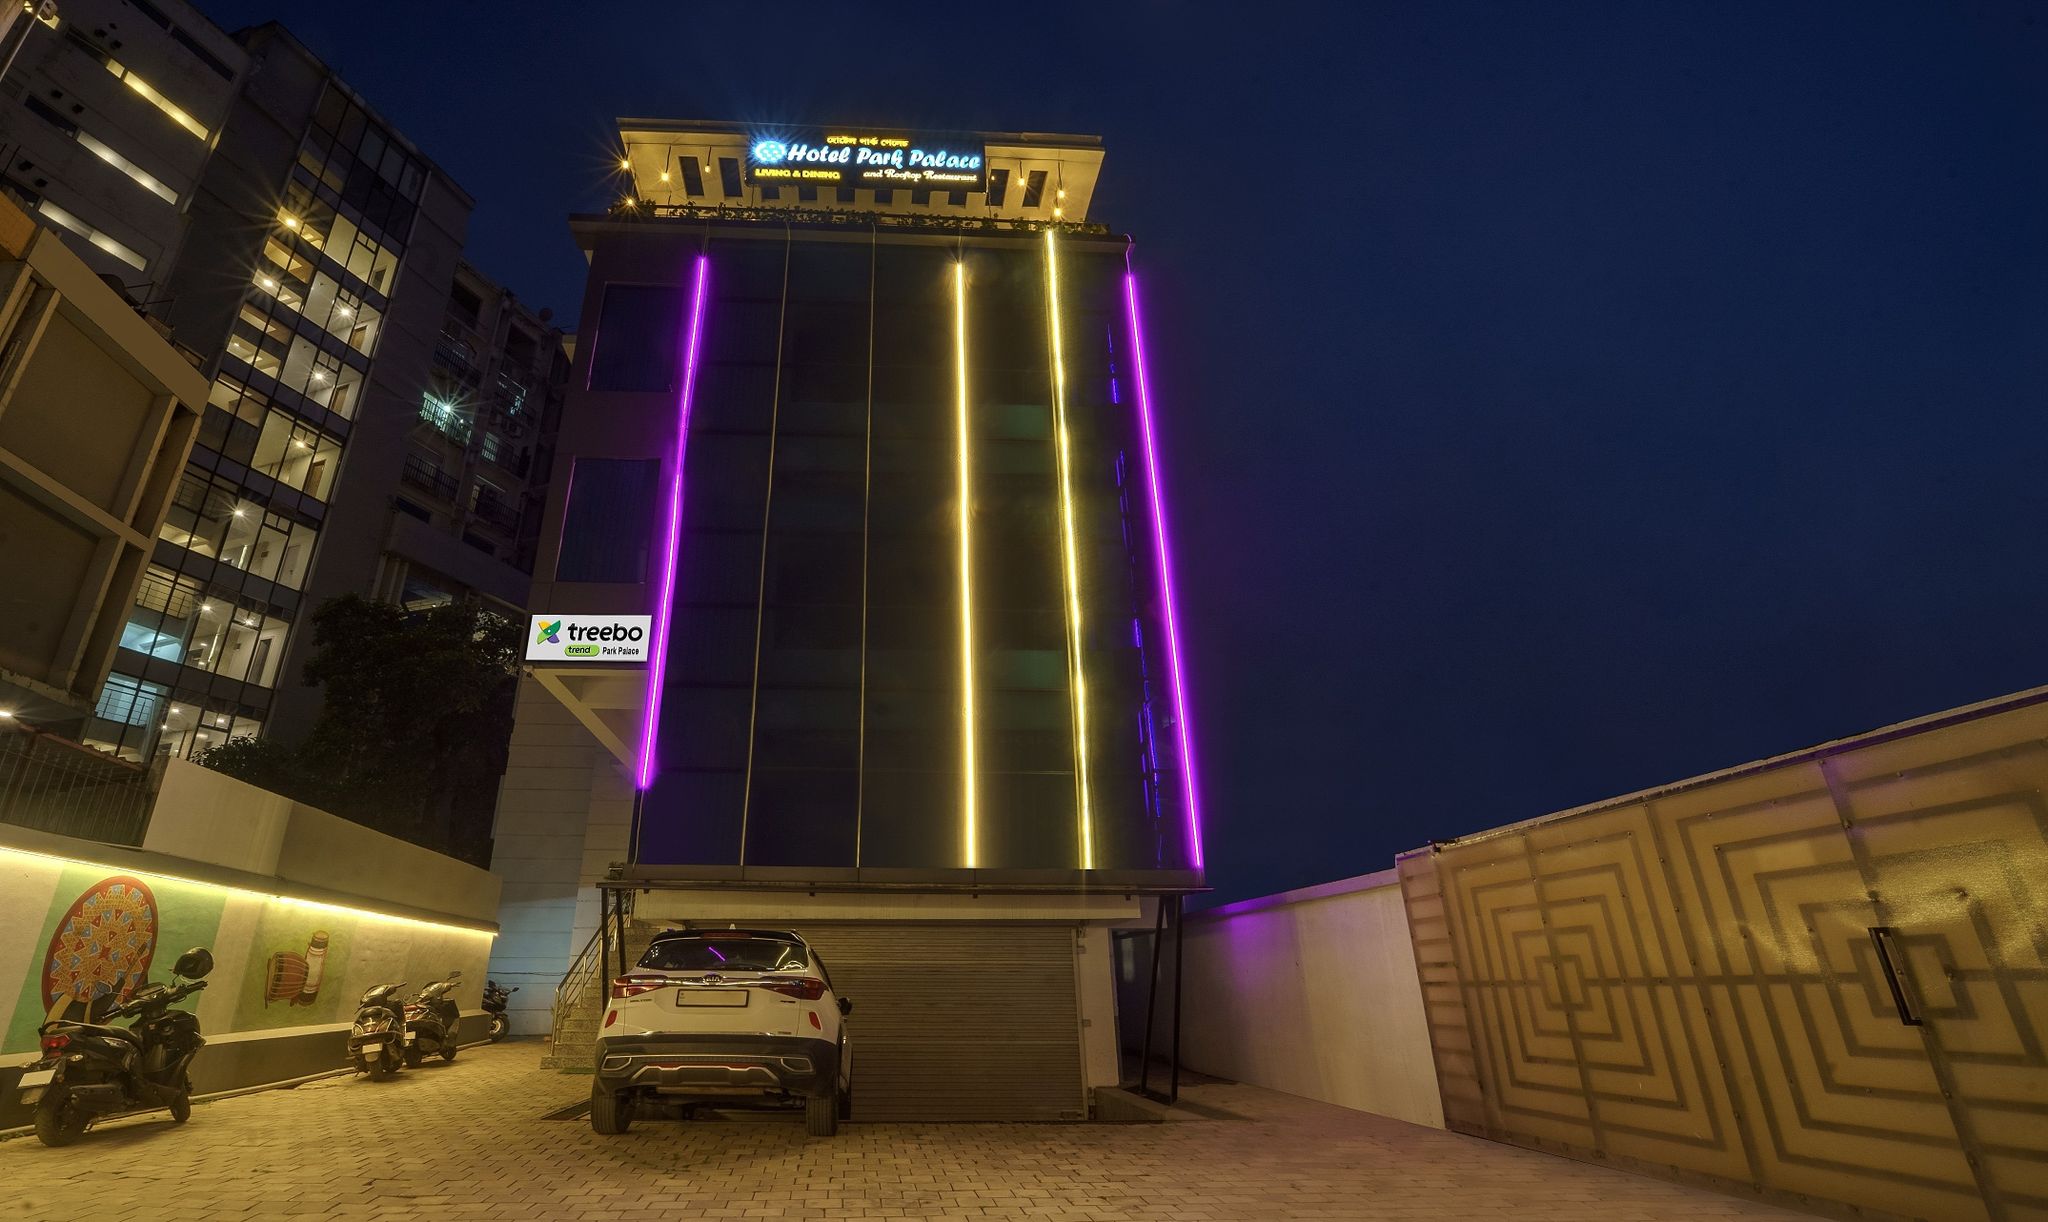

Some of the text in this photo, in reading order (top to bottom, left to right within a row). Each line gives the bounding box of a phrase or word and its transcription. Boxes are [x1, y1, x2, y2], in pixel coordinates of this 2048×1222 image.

[787, 143, 981, 170] Hotel Park Palace
[755, 168, 841, 179] LIVING & DINING
[863, 168, 978, 182] and Rooftop Restaurant
[567, 622, 643, 642] treebo
[568, 646, 591, 654] trend
[602, 646, 640, 655] Park Palace
